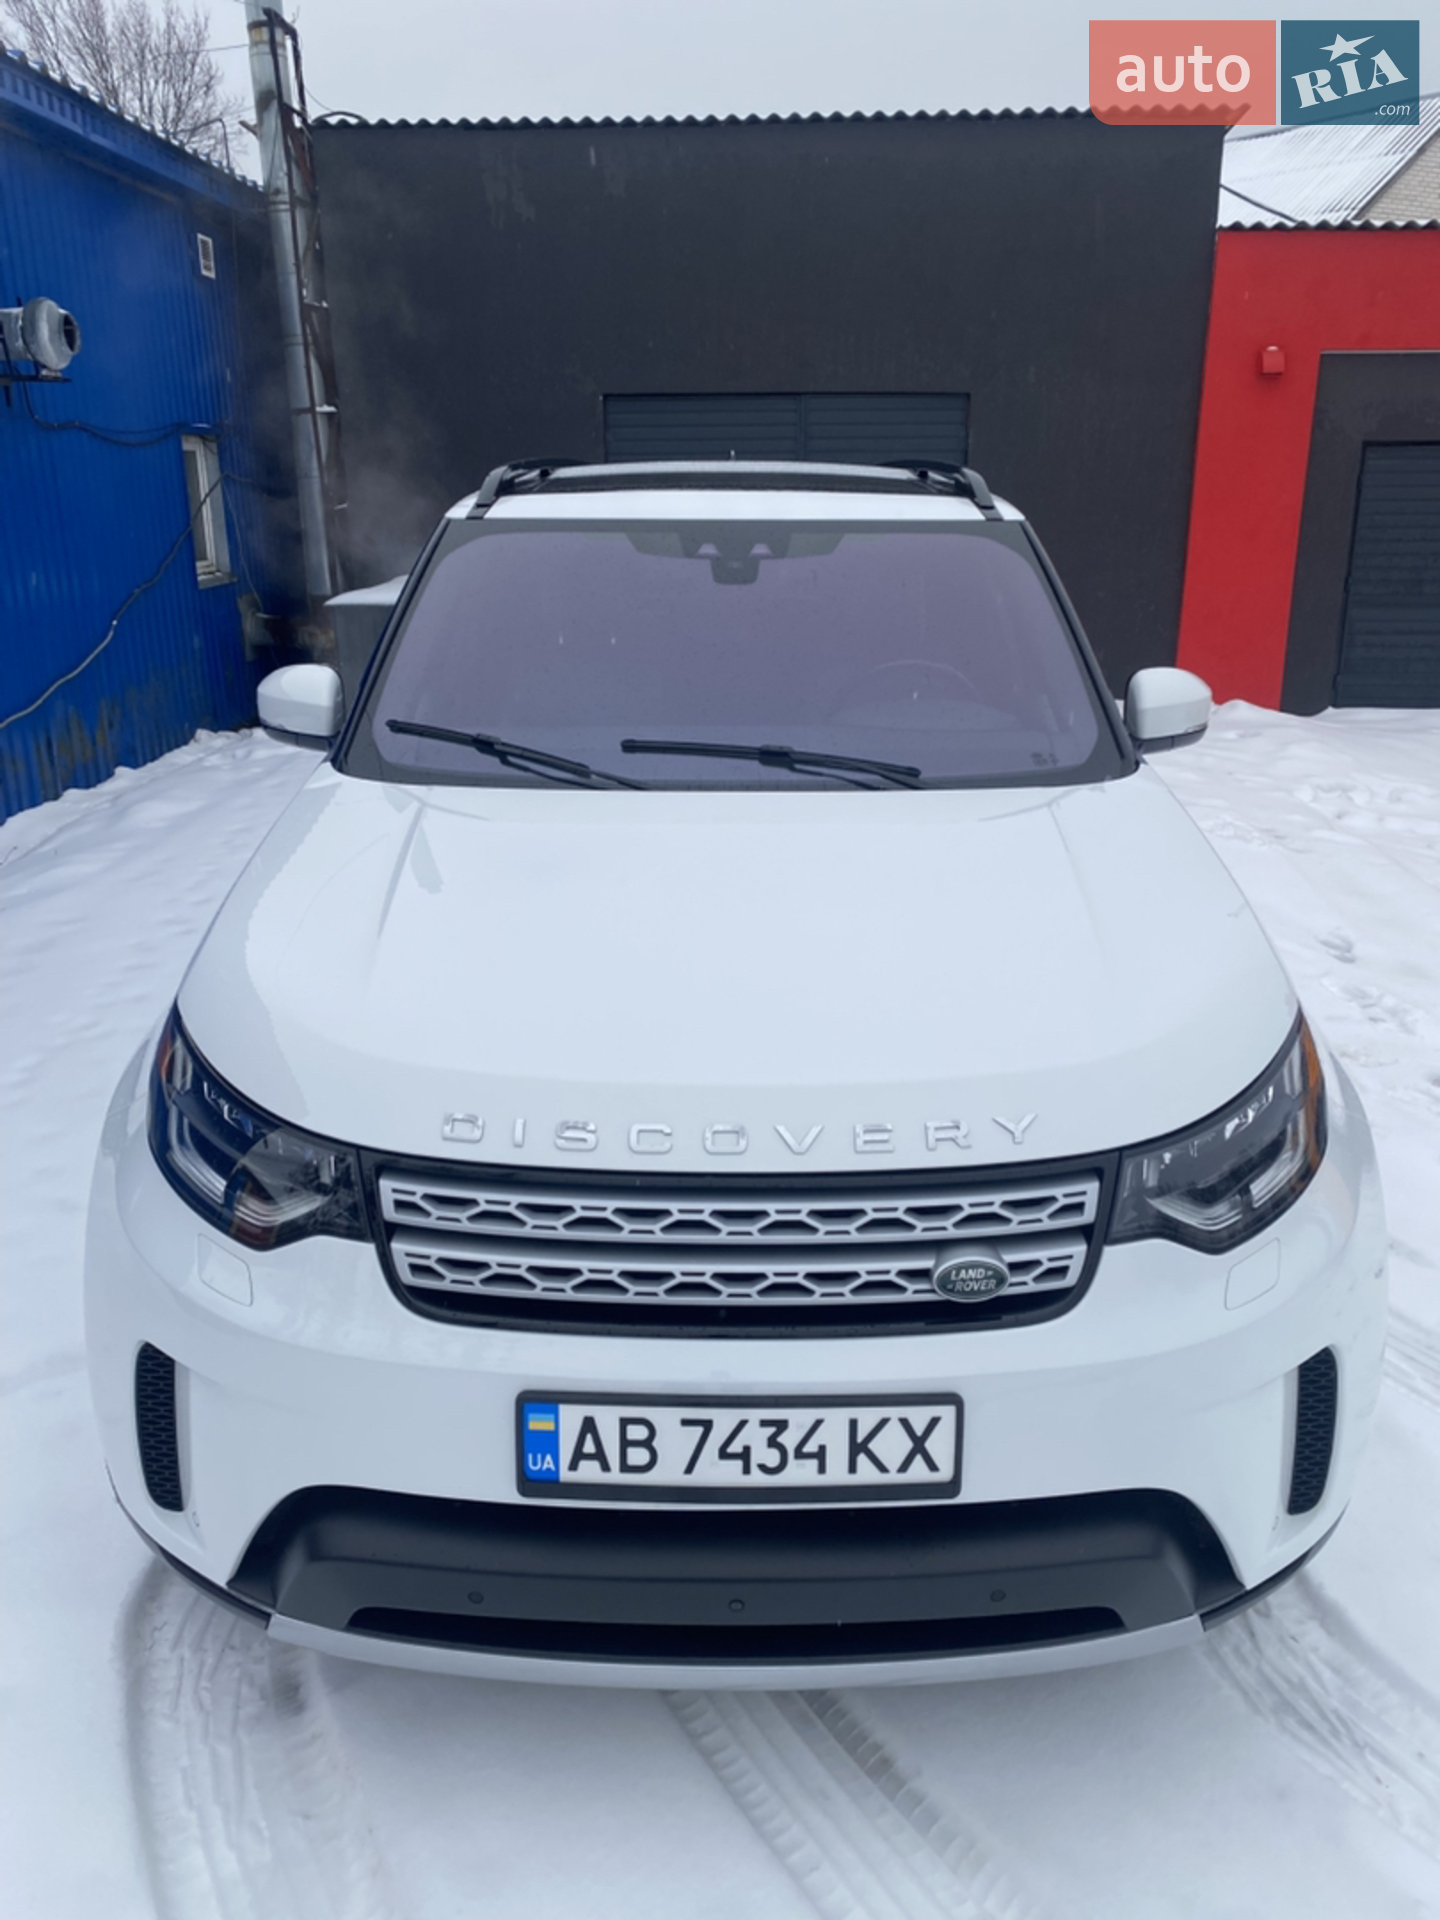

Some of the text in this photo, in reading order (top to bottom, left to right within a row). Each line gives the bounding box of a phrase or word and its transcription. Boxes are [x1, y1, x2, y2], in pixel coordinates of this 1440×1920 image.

[441, 1112, 1038, 1156] DISCOVERY
[528, 1453, 556, 1472] UA
[567, 1416, 943, 1476] AB 7434 KX
